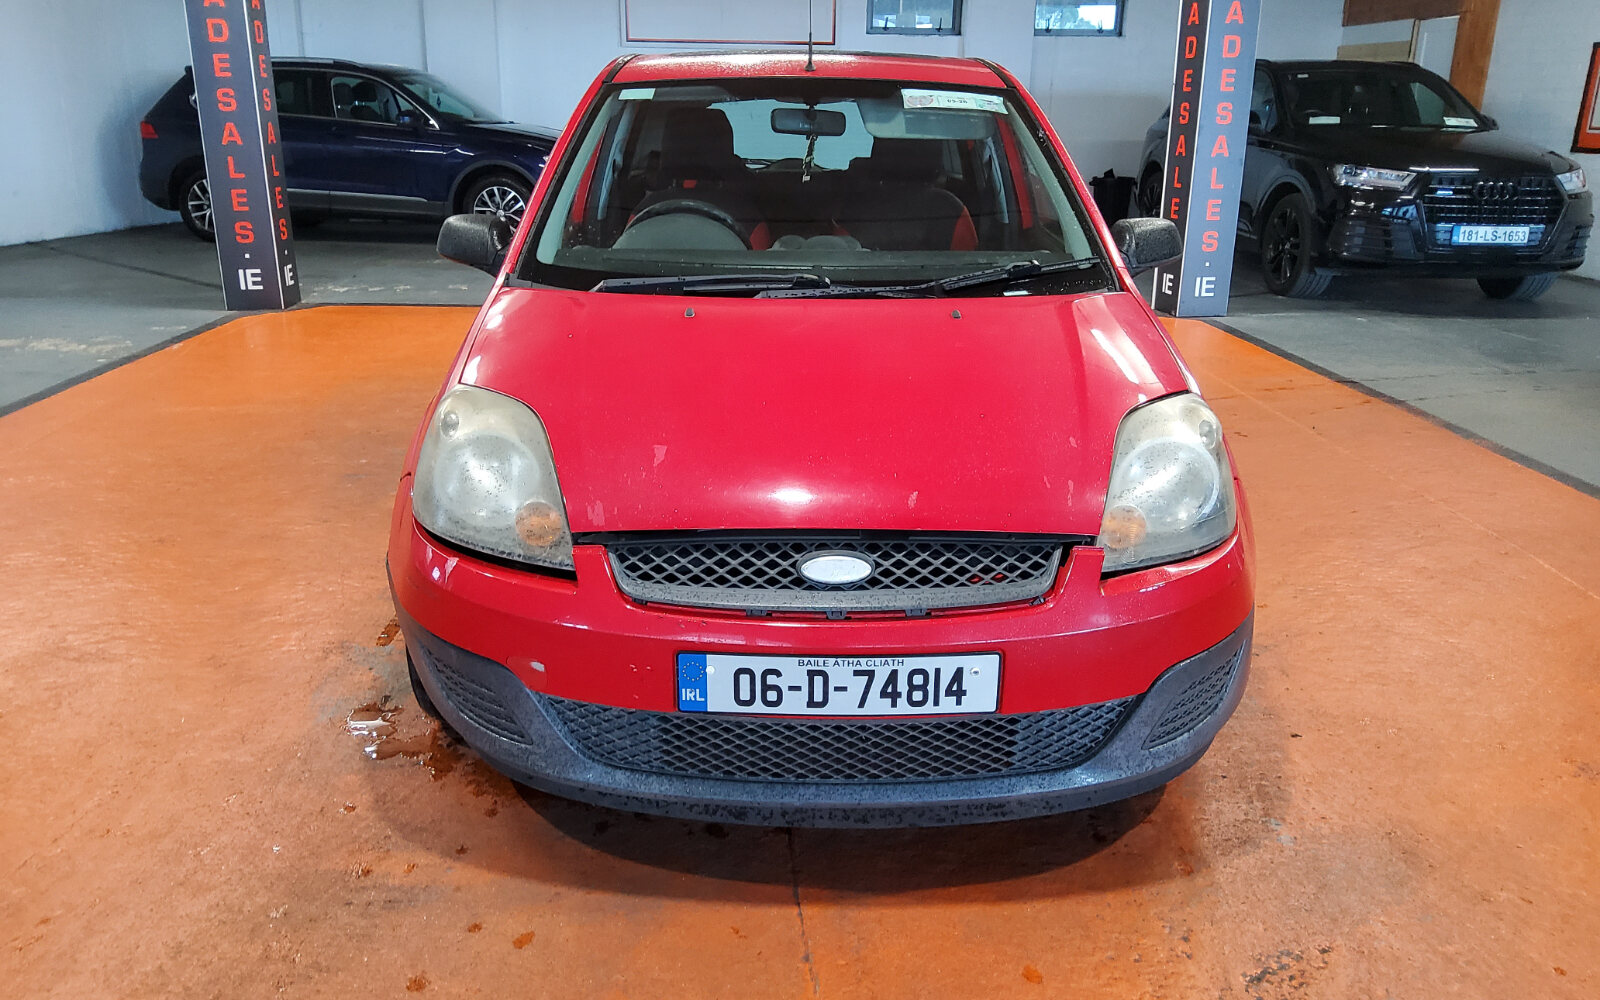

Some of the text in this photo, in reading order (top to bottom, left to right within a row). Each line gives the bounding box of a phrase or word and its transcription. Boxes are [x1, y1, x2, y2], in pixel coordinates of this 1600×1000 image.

[203, 0, 264, 290] DESALES.IE
[1461, 229, 1526, 242] 181-LS-1653
[798, 657, 905, 668] BAILE ÁTHA CLIATH
[682, 688, 705, 702] IRL
[733, 667, 967, 709] 06-D-74814
